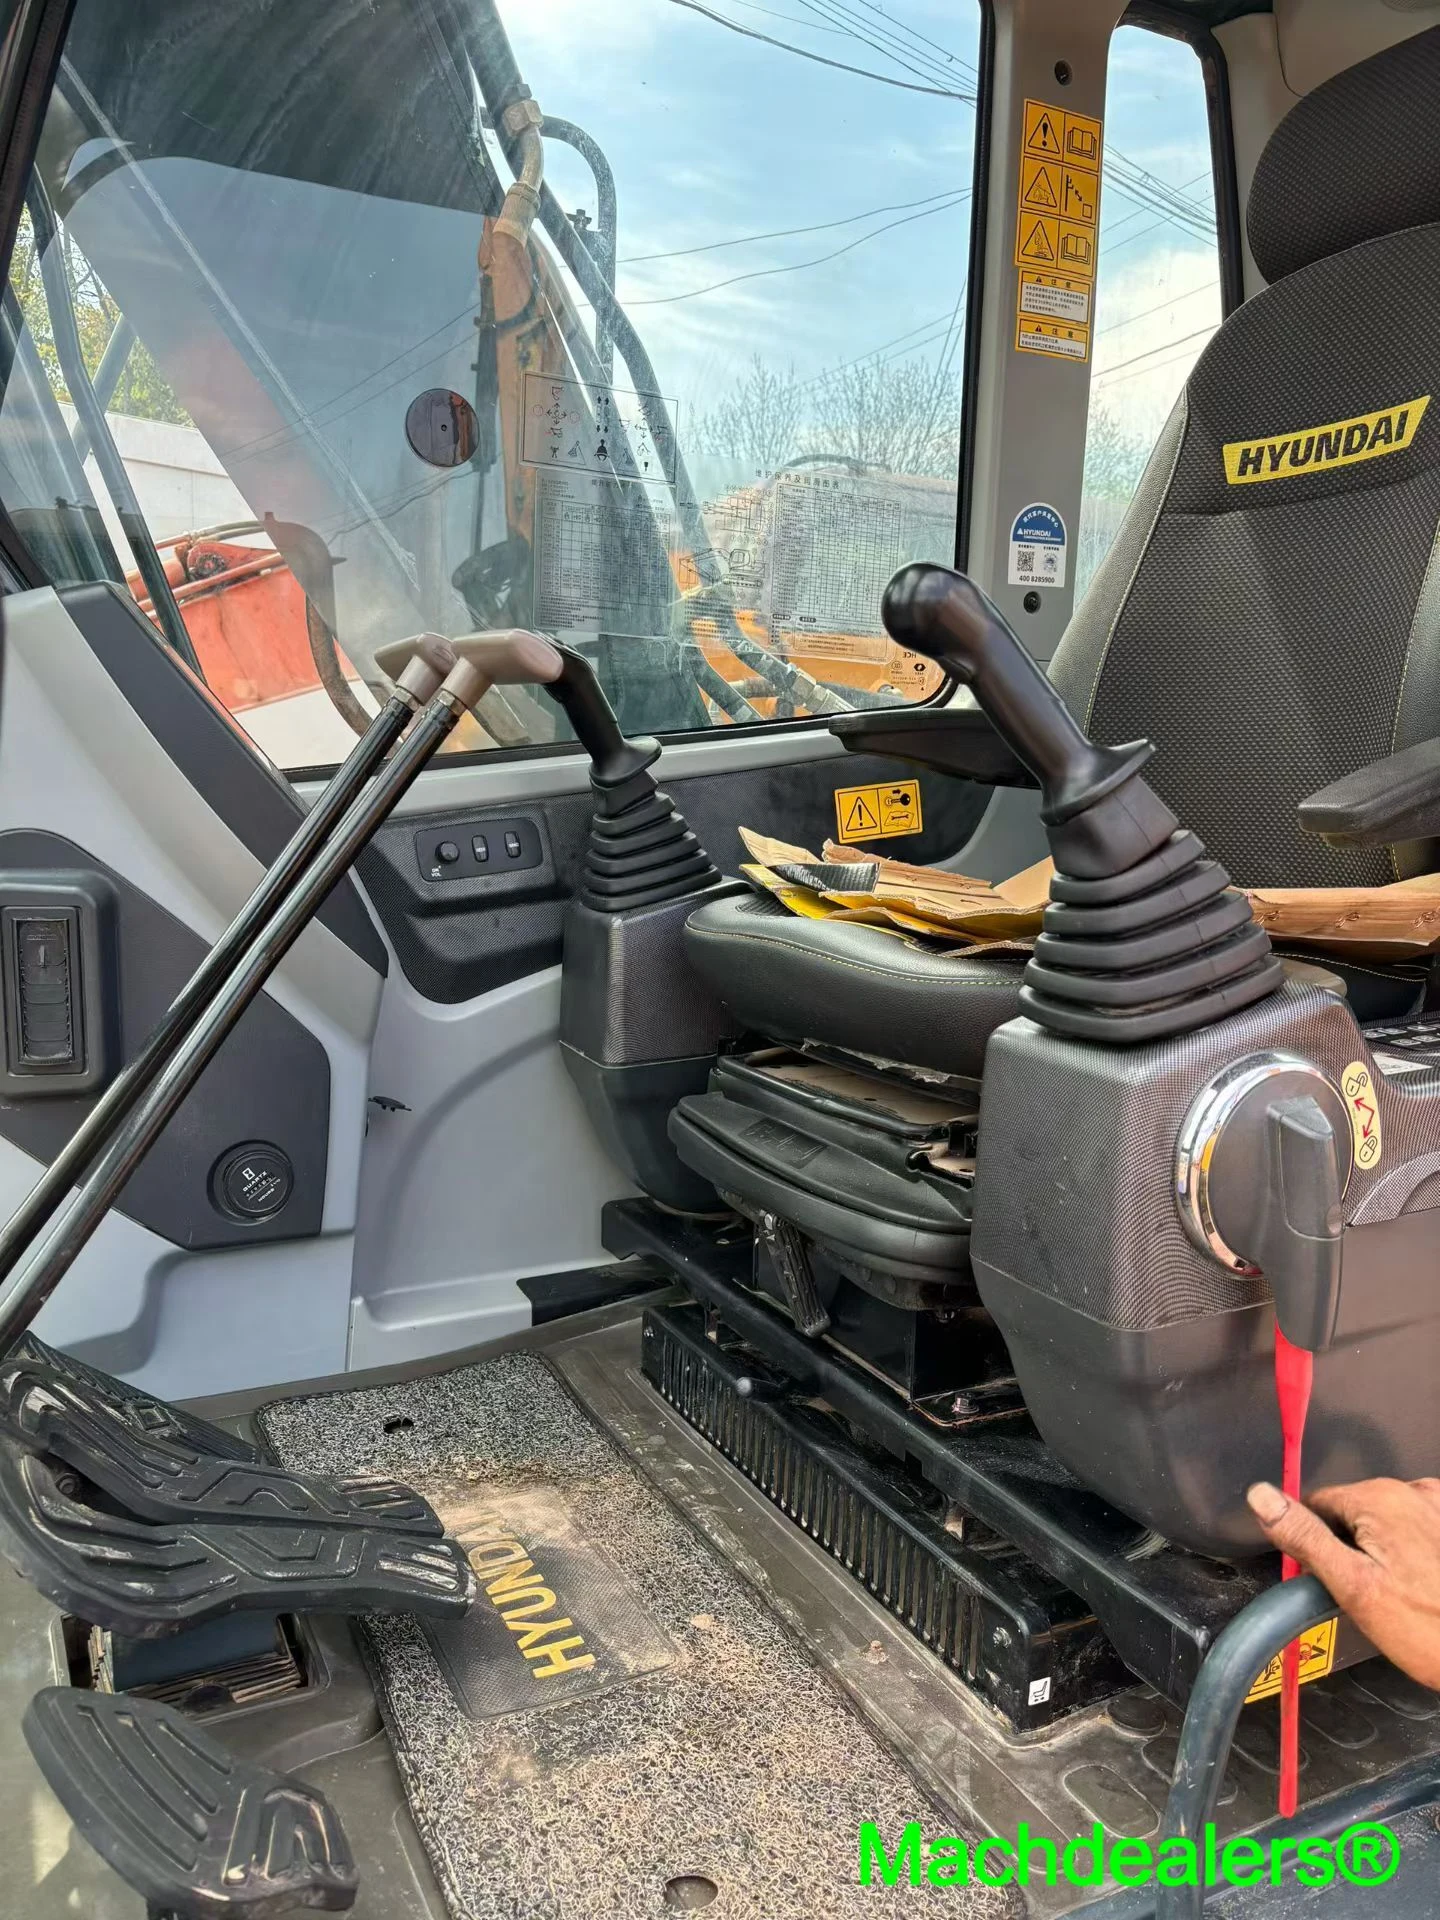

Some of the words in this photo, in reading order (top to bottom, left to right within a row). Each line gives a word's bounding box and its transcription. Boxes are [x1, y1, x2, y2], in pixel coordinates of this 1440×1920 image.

[1237, 409, 1410, 477] HYUNDAI
[1023, 529, 1051, 537] HYUNDAI
[1031, 575, 1055, 584] 8285900
[243, 1171, 267, 1191] QUARTZ
[258, 1188, 275, 1202] HOURS
[452, 1511, 596, 1679] HYUNDAI
